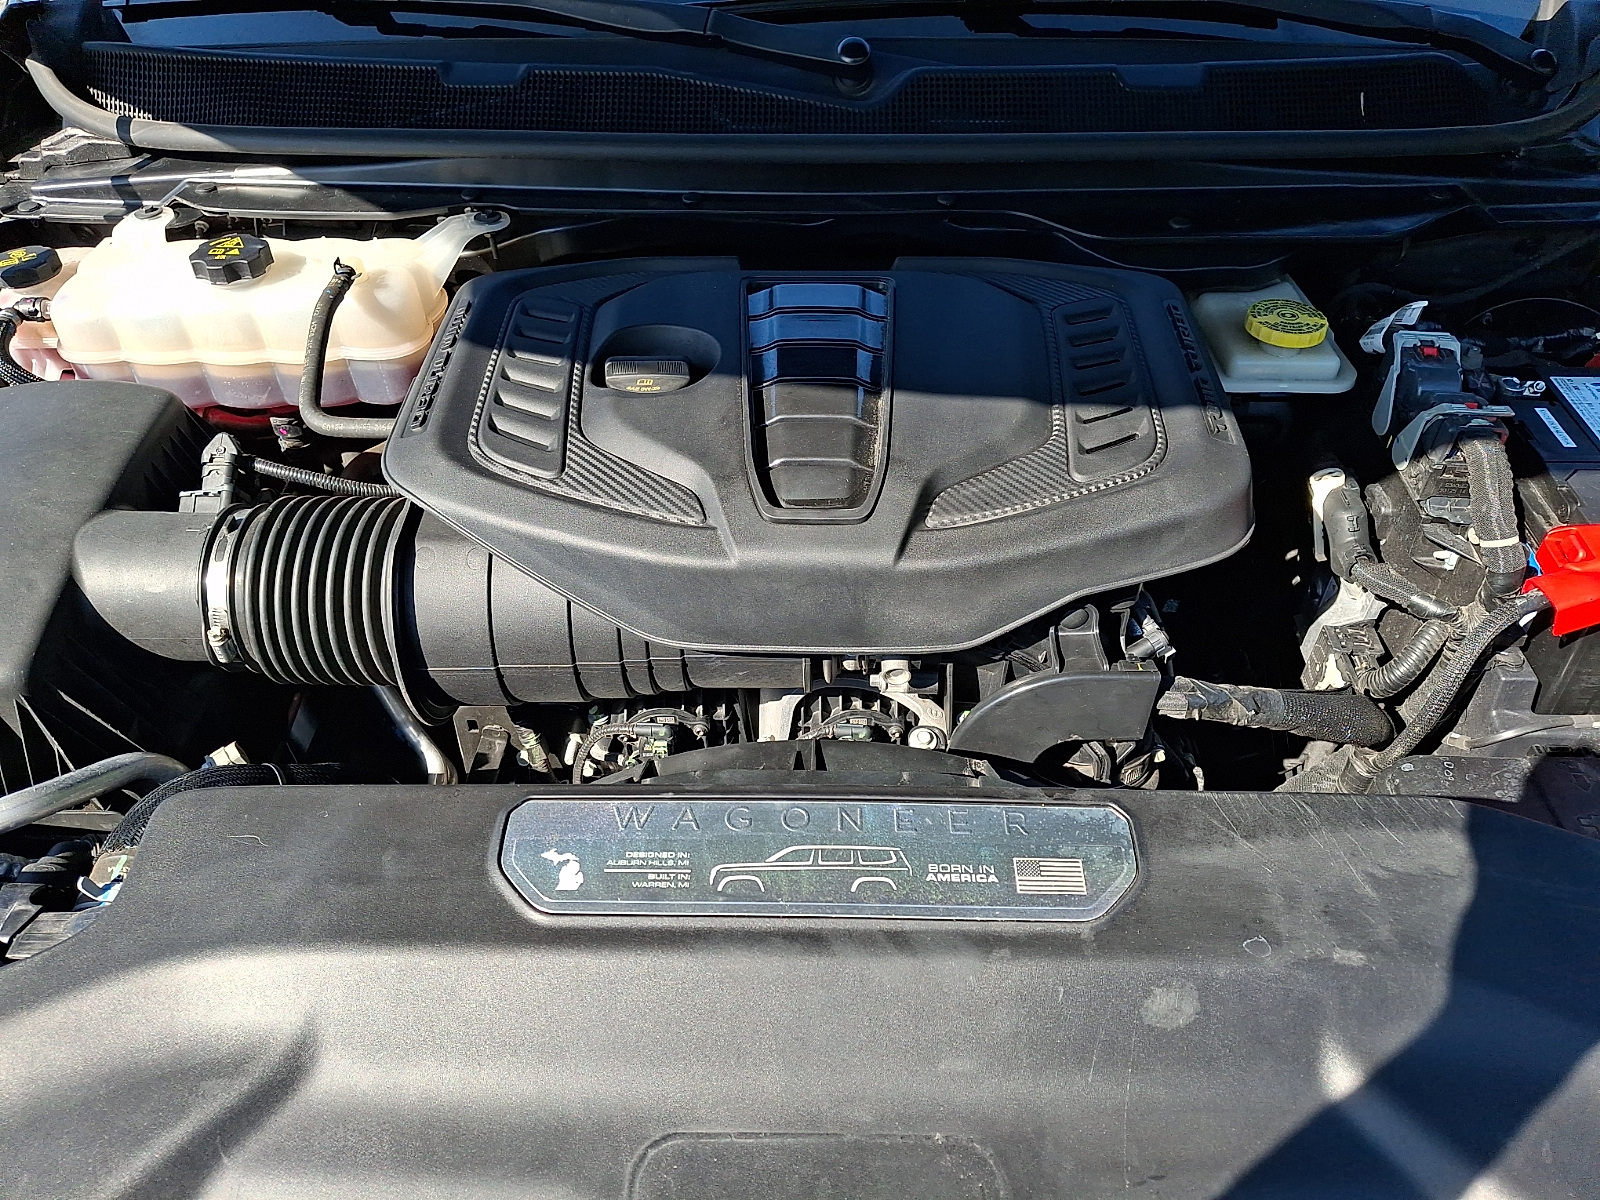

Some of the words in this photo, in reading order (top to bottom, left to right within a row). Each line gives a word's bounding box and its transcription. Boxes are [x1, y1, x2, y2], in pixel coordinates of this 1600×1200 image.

[613, 805, 1029, 835] WAGONEER
[928, 863, 973, 873] BORN
[979, 864, 995, 873] IN
[925, 873, 999, 882] AMERICA
